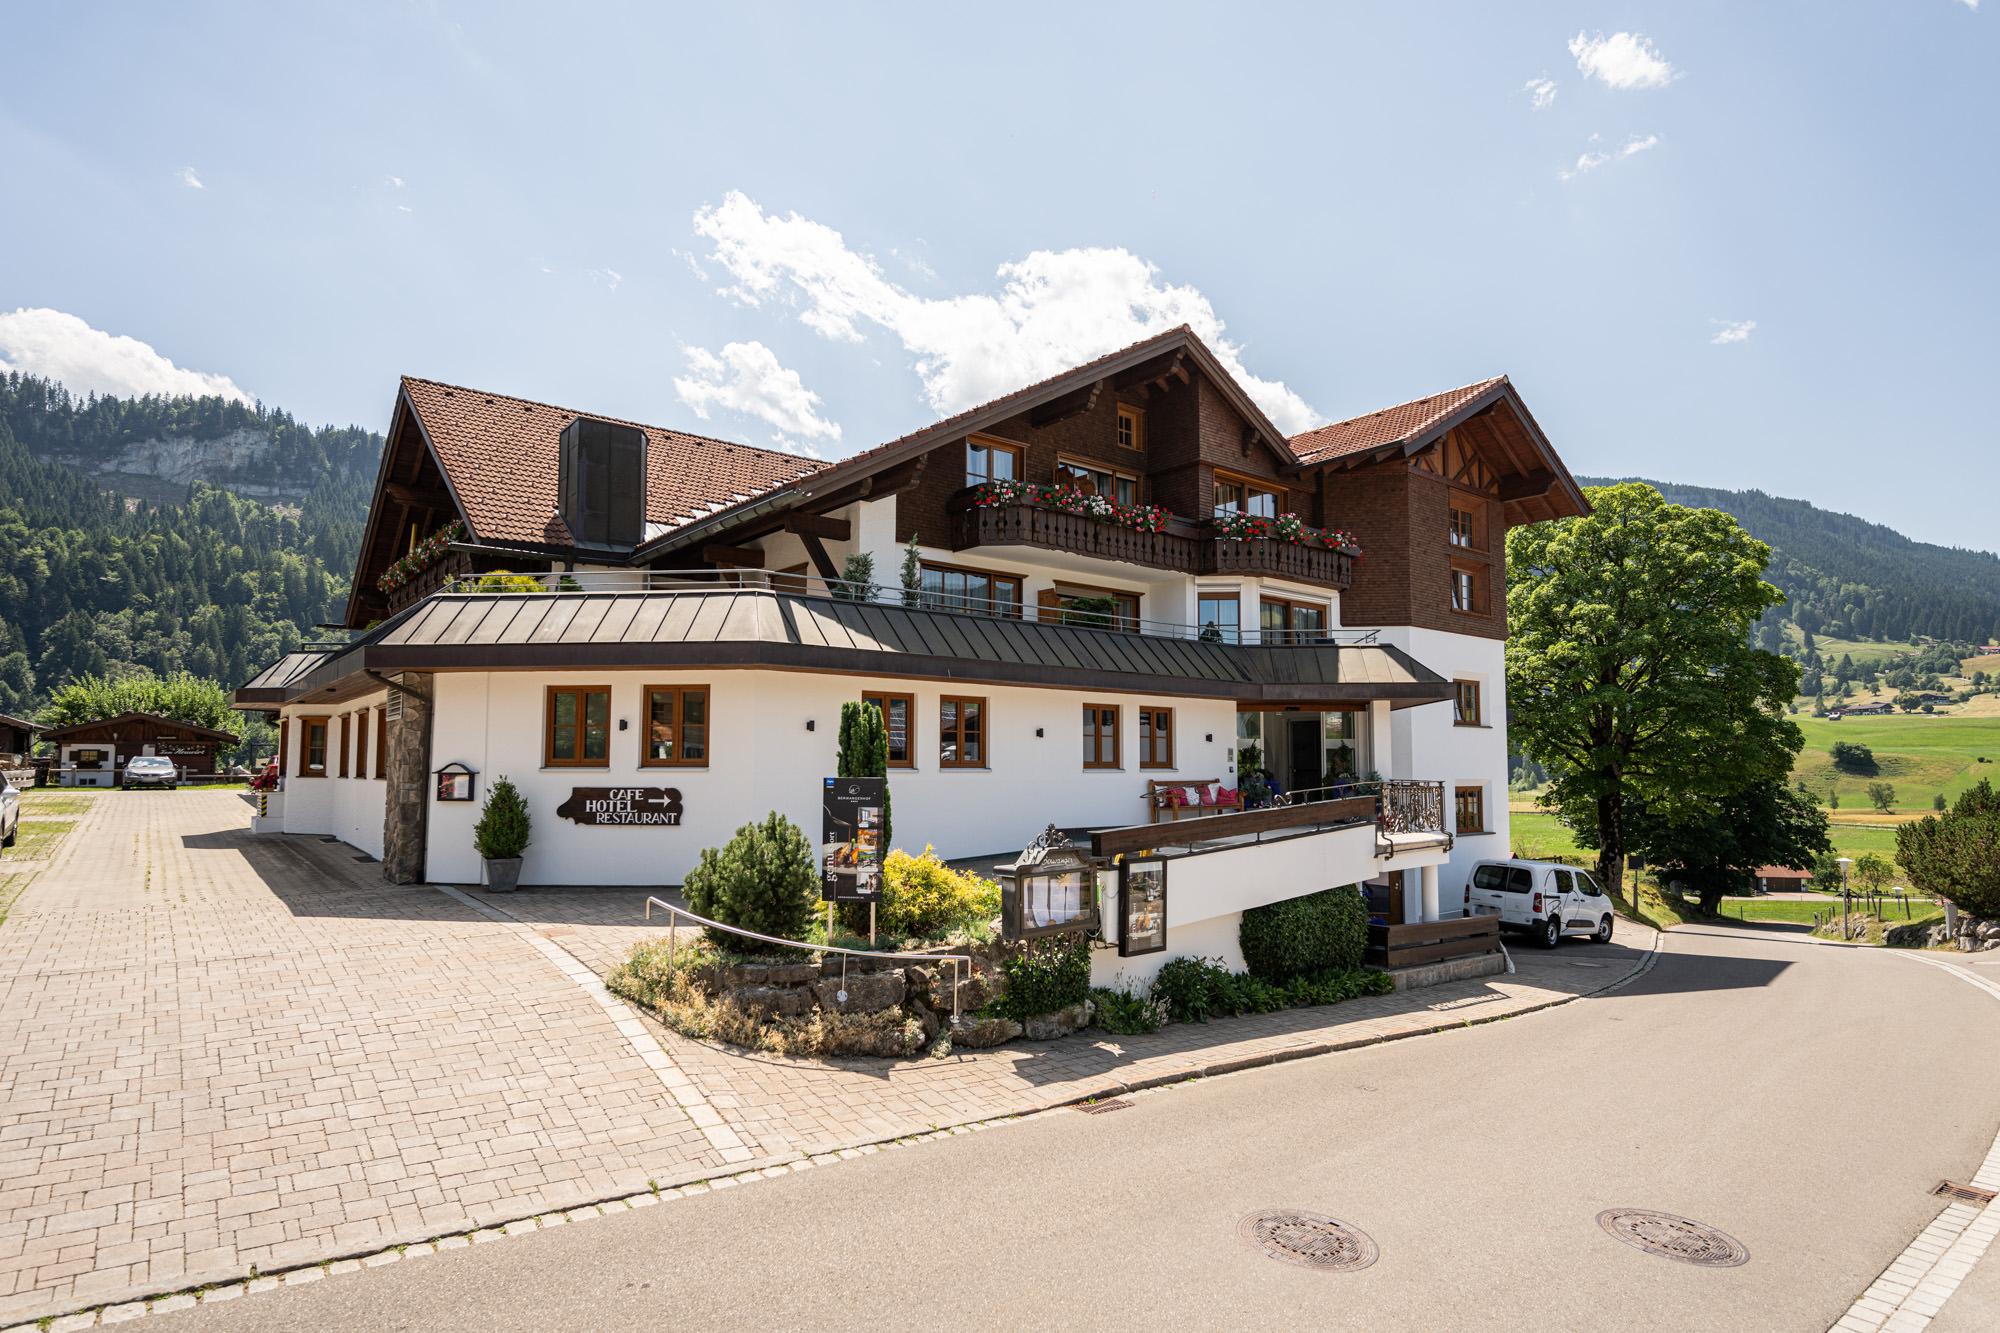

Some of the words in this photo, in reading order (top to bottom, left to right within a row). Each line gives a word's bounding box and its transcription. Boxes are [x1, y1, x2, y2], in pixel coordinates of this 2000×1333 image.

[609, 789, 644, 800] CAFE
[585, 800, 637, 813] HOTEL
[596, 812, 678, 824] RESTAURANT
